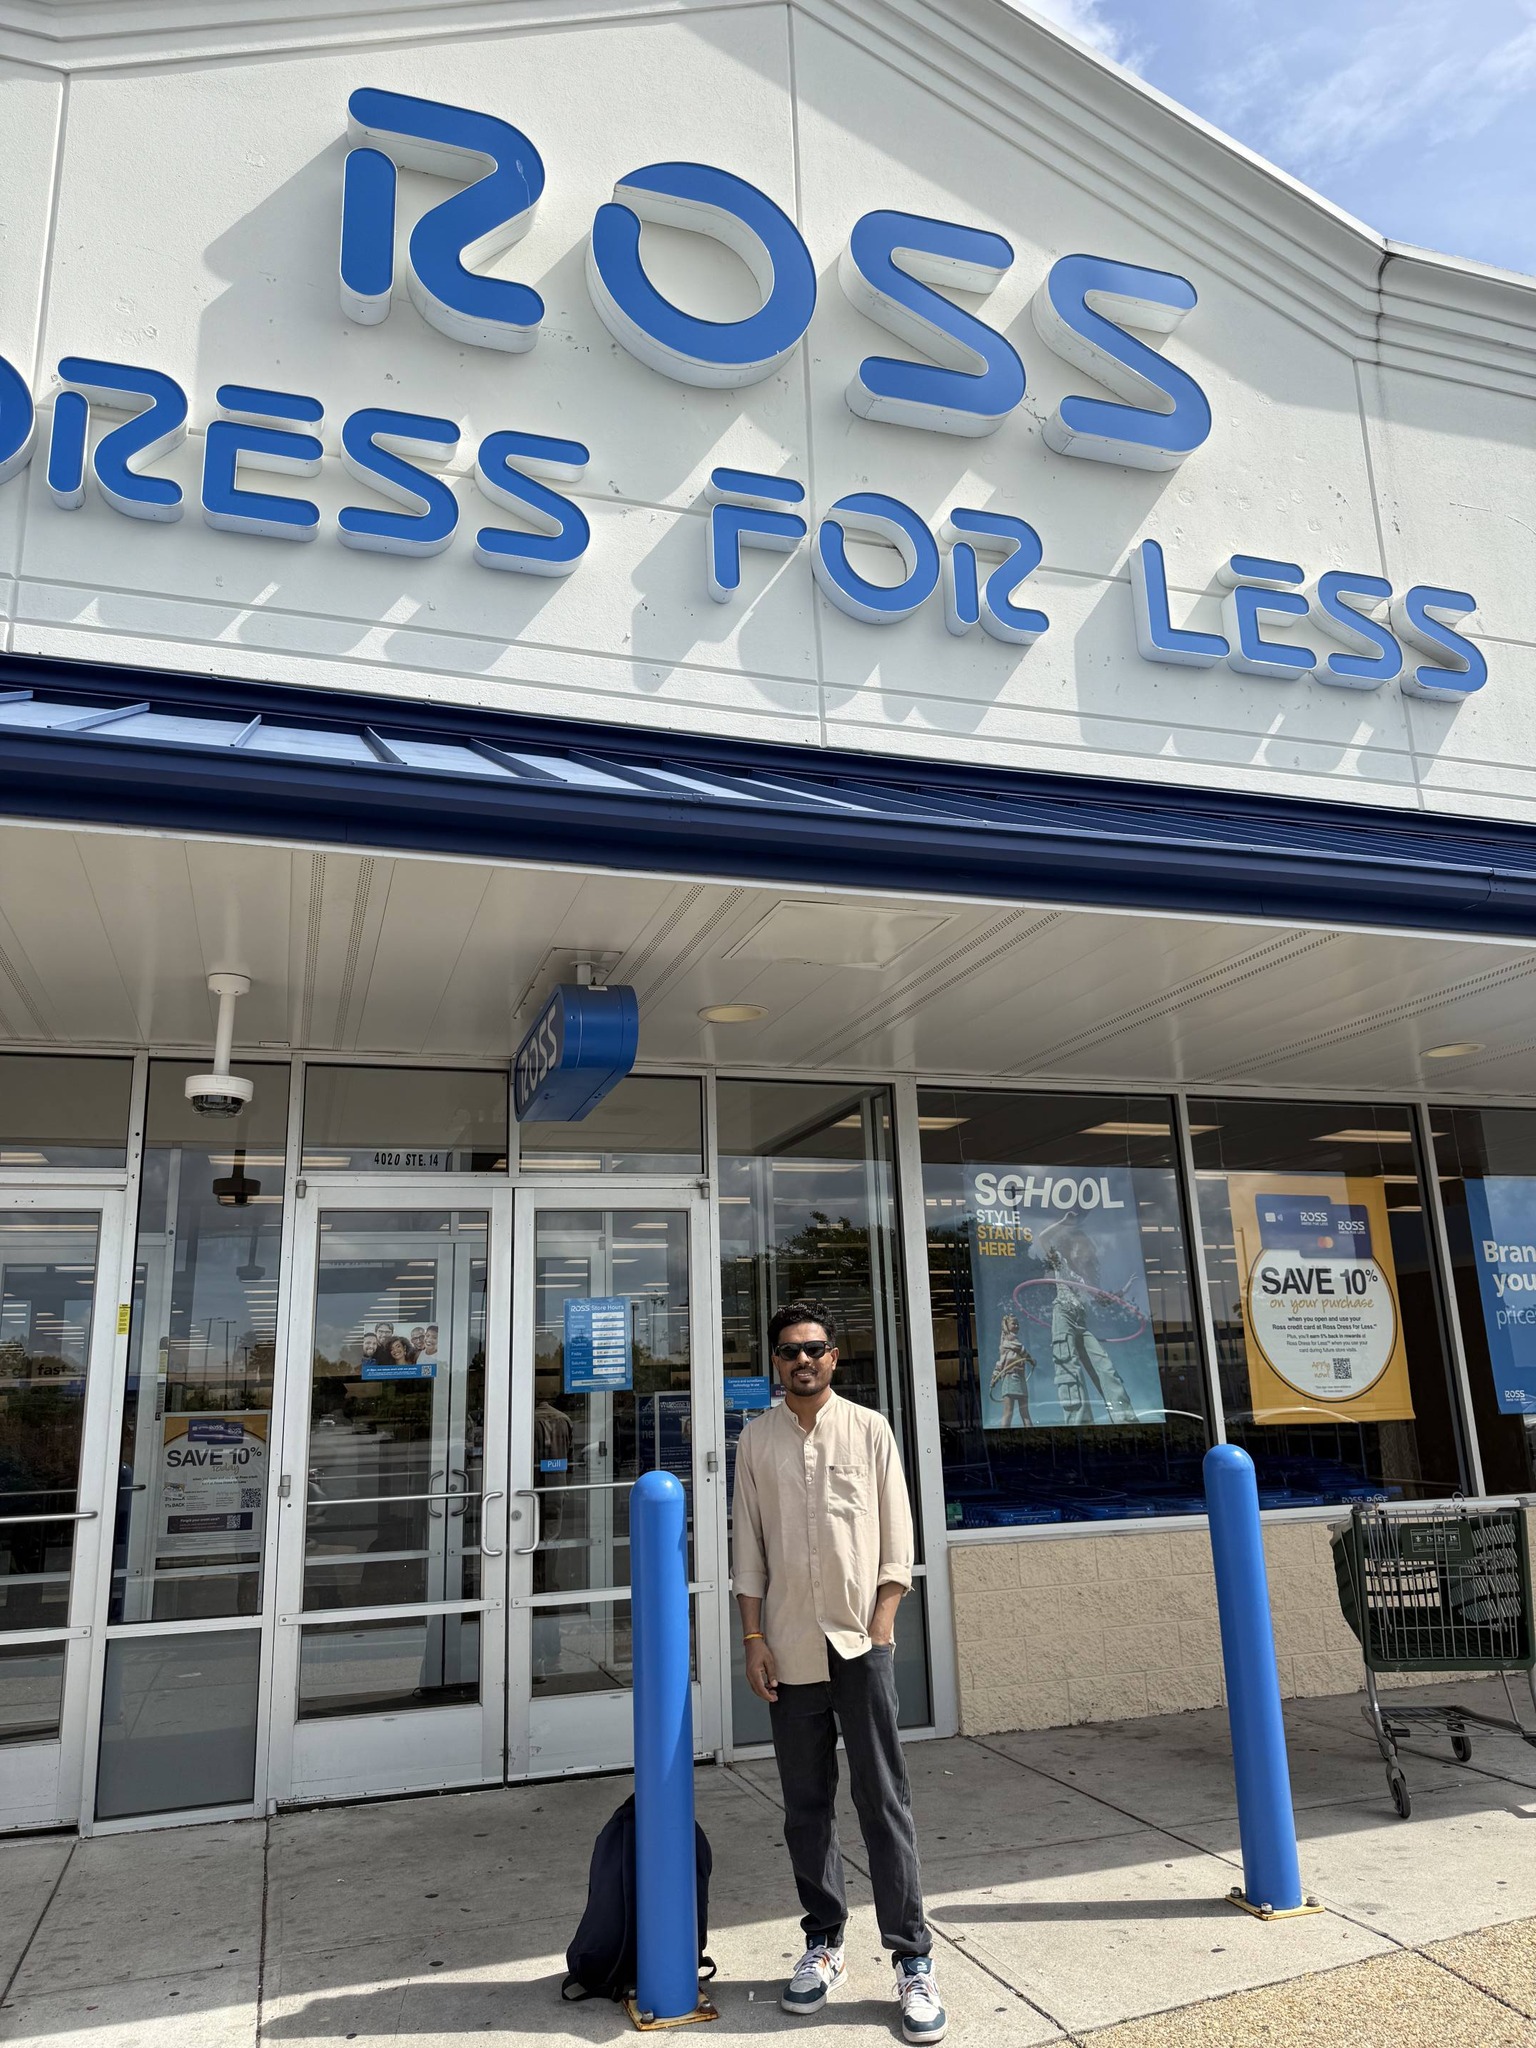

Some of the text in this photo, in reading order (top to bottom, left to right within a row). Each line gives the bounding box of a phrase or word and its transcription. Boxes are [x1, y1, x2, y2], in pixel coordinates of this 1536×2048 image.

[340, 87, 1212, 466] ROSS
[706, 467, 1049, 643] FOR
[1131, 539, 1488, 702] LESS
[521, 1004, 557, 1105] ROSS
[374, 1152, 401, 1166] 4020
[429, 1154, 439, 1166] 14
[974, 1172, 1125, 1210] SCHOOL
[976, 1209, 1021, 1225] STYLE
[1300, 1212, 1328, 1222] ROSS
[1338, 1220, 1365, 1231] ROSS
[977, 1225, 1033, 1242] STARTS
[978, 1241, 1016, 1257] HERE
[1260, 1266, 1379, 1295] SAVE 10%
[1270, 1296, 1375, 1314] on your purchase
[1504, 1390, 1526, 1398] ROSS
[166, 1447, 262, 1467] SAVE 10%
[547, 1460, 561, 1468] Pull
